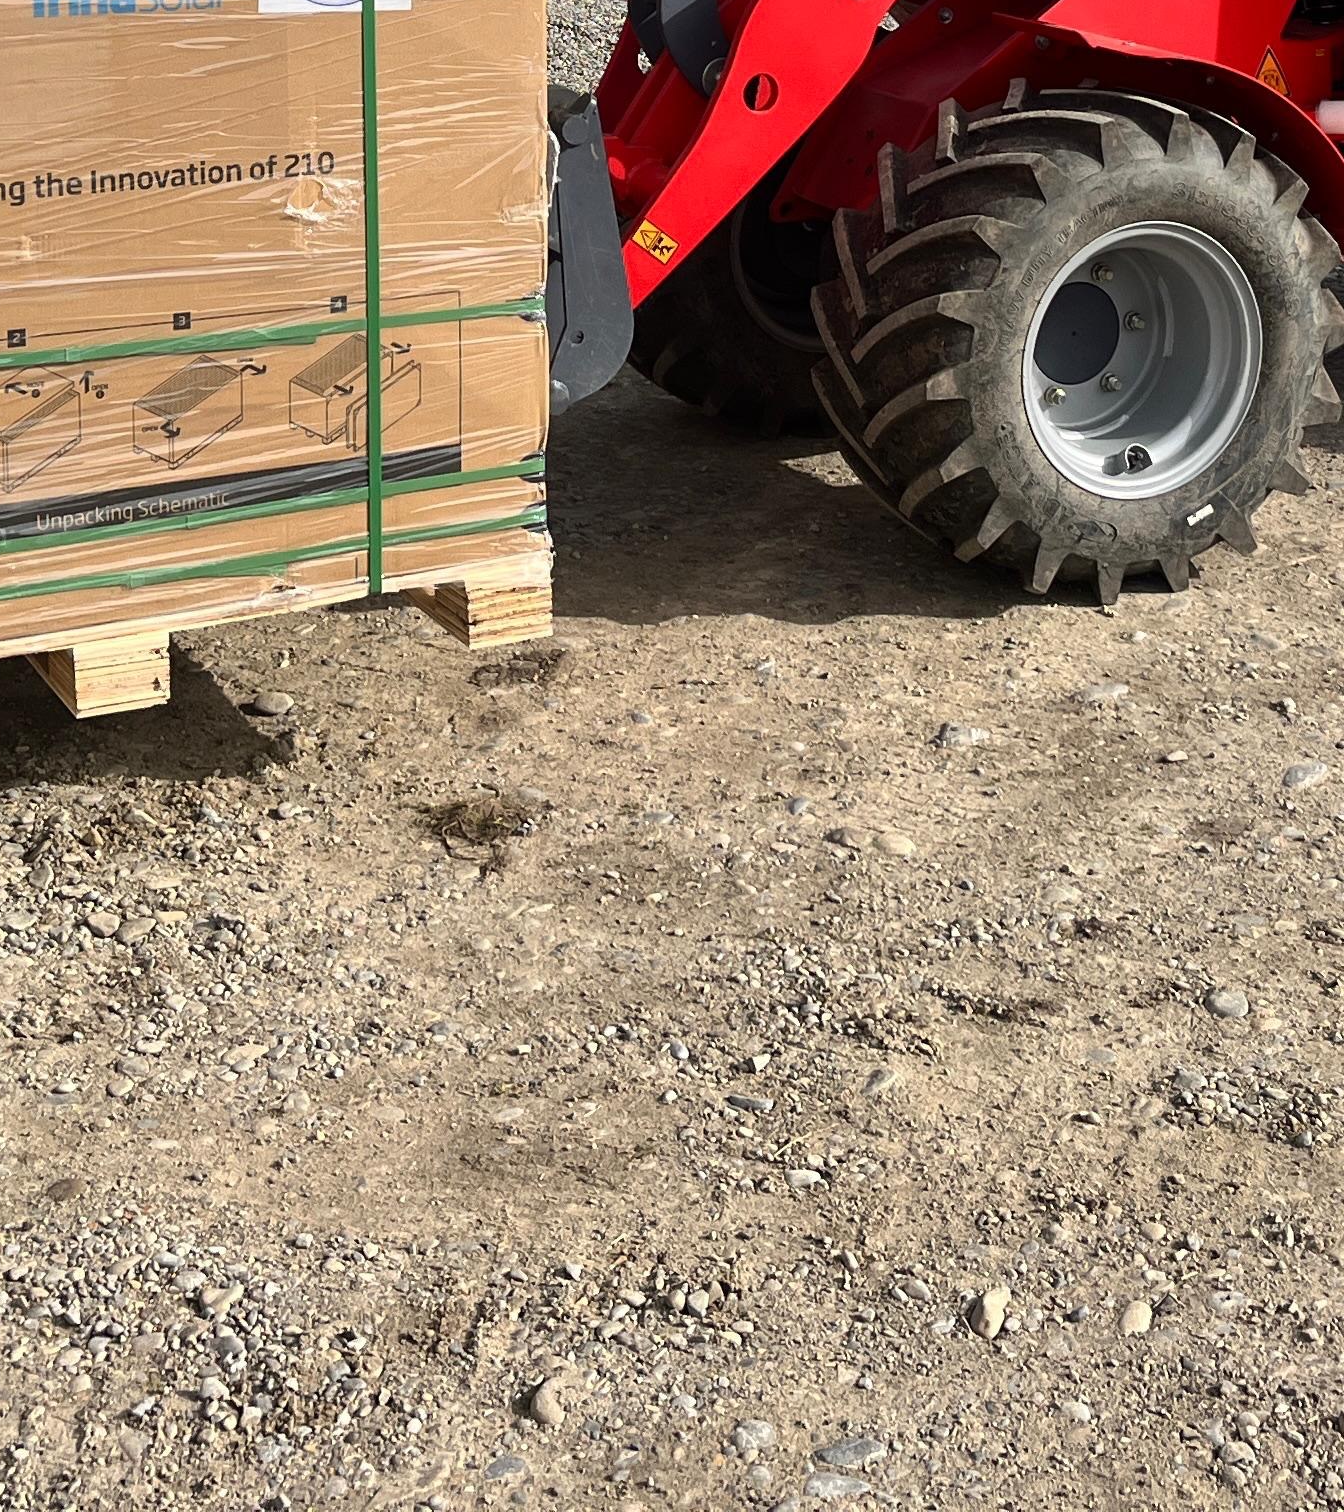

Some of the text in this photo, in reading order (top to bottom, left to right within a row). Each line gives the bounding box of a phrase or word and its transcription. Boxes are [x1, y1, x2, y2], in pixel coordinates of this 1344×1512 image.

[33, 172, 82, 199] the
[91, 161, 242, 194] Innovation
[249, 156, 277, 180] of
[284, 151, 335, 178] 210
[36, 491, 231, 532] Unpacking Schematic
